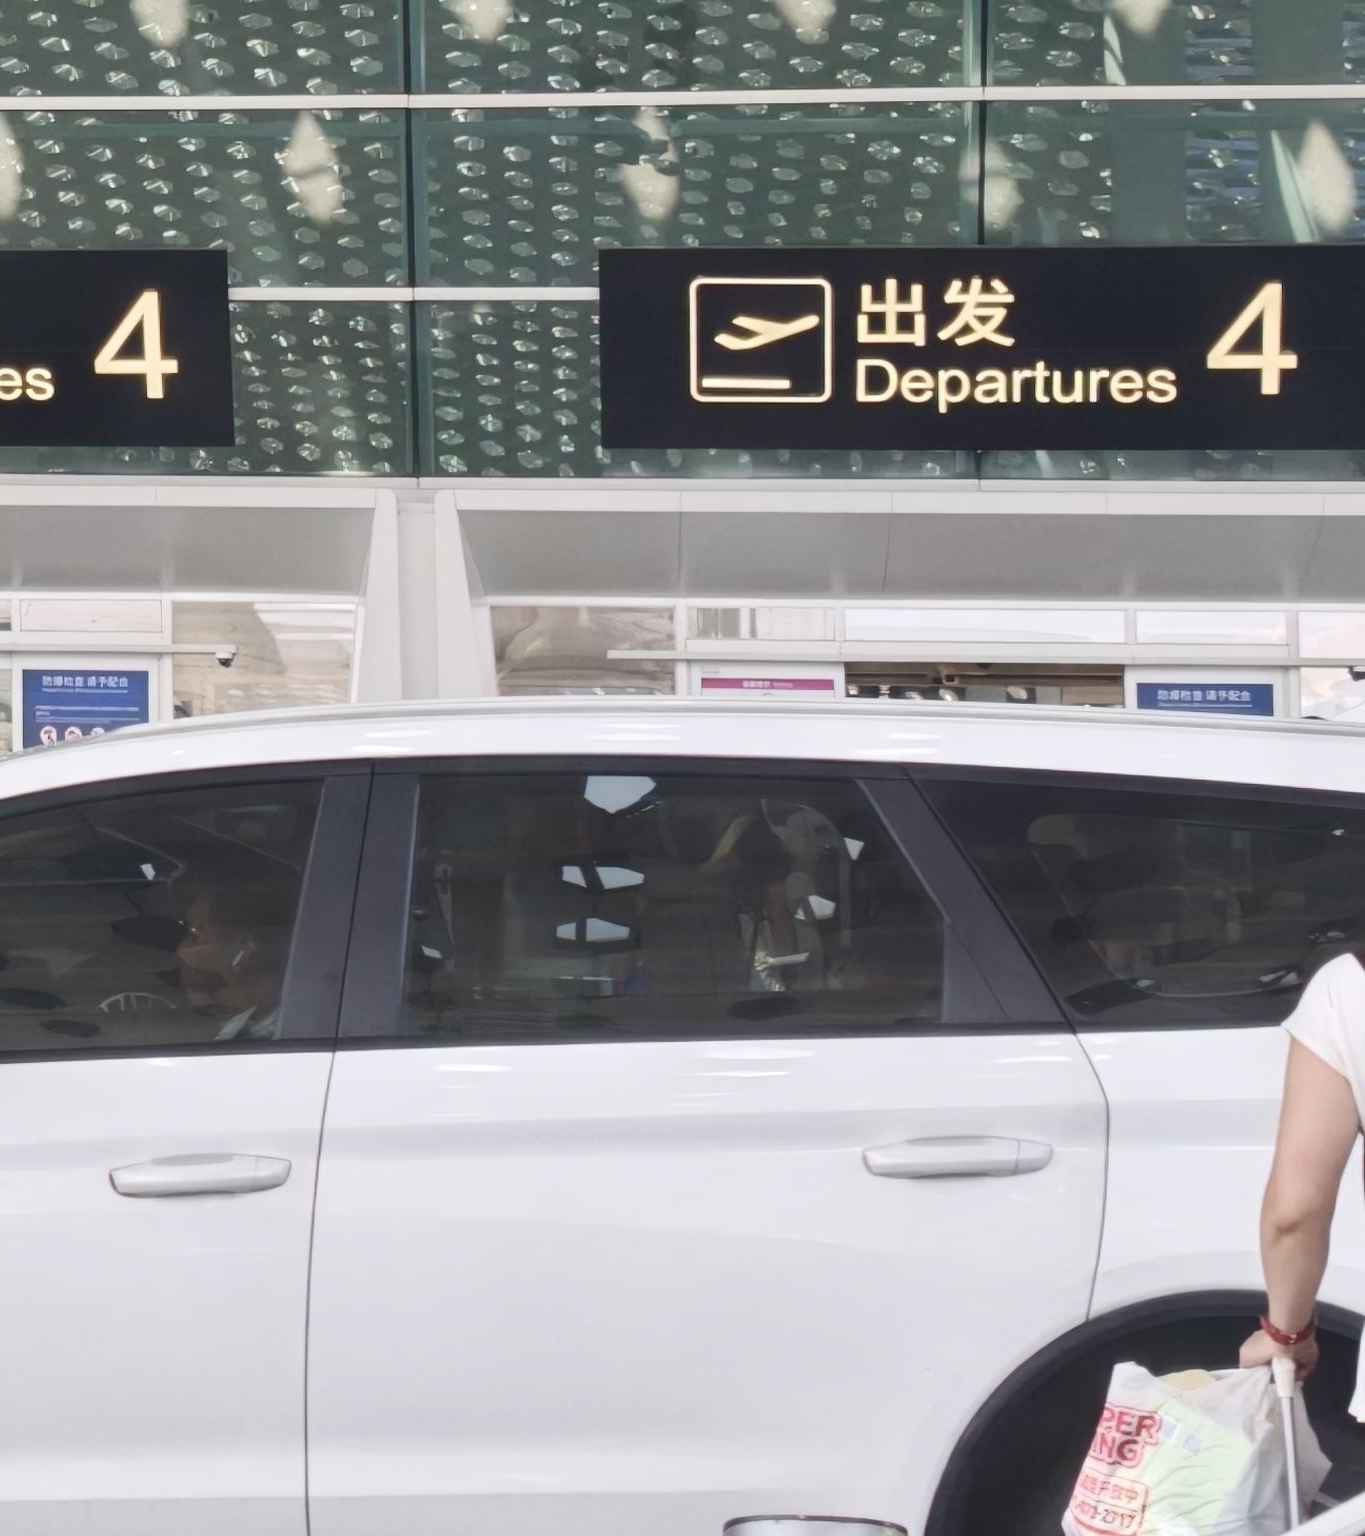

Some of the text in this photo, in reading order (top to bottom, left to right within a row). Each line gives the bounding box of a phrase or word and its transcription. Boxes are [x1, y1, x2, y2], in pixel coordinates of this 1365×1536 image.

[93, 289, 180, 400] 4
[856, 277, 1017, 348] 出发
[1206, 281, 1299, 396] 4
[855, 359, 1178, 413] Departures
